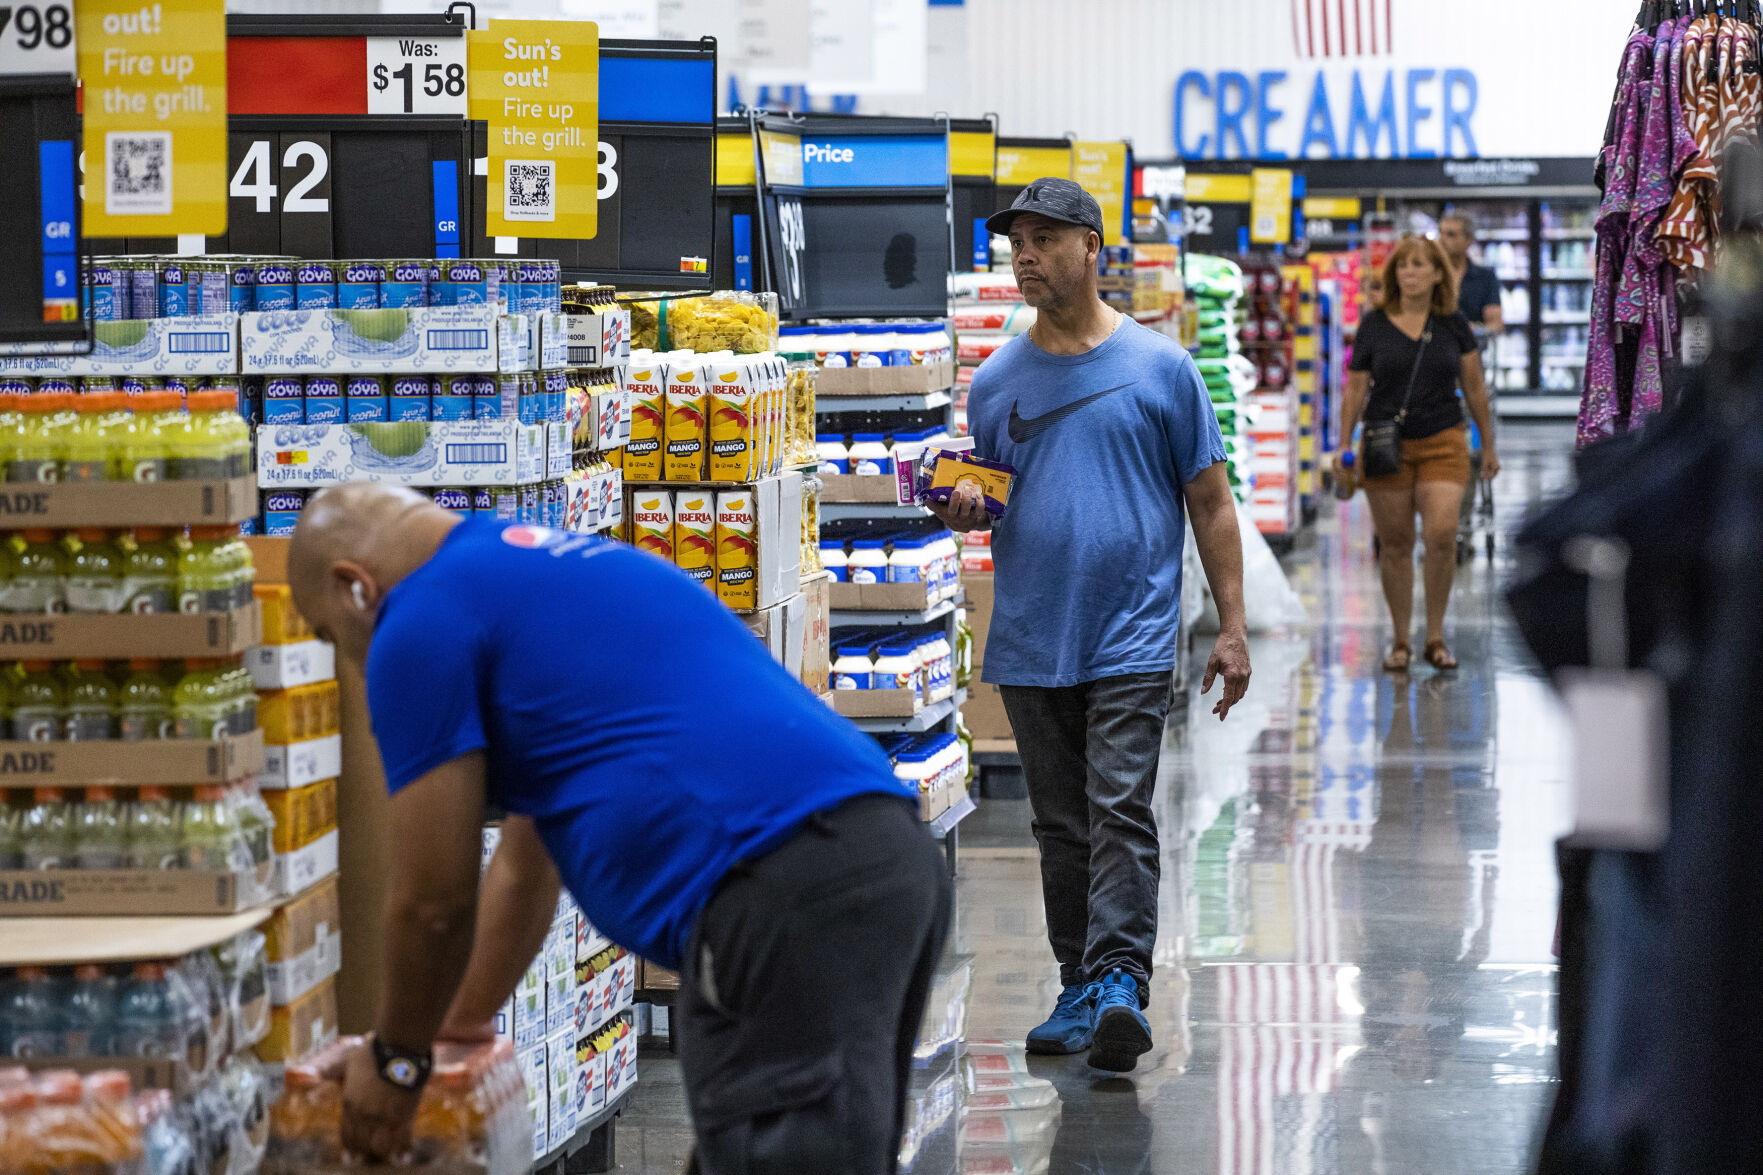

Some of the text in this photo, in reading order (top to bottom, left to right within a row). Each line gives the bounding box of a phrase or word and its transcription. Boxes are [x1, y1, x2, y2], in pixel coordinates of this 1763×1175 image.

[103, 8, 161, 33] out!
[399, 40, 438, 58] Was:
[504, 38, 561, 60] Sun's
[103, 48, 194, 80] Fire up
[503, 66, 548, 88] out!
[103, 87, 212, 119] the grill.
[504, 98, 573, 124] Fire up
[1172, 68, 1479, 160] CREAMER
[502, 126, 586, 151] the grill.
[804, 144, 854, 162] Price
[46, 221, 71, 238] GR
[438, 220, 456, 232] GR
[736, 255, 749, 264] GR
[259, 270, 292, 284] GOYA
[298, 270, 333, 282] GOYA
[346, 269, 378, 282] GOYA
[395, 268, 422, 282] GOY
[4, 358, 18, 369] 17.6
[248, 355, 256, 366] 24
[264, 354, 278, 366] 17.6
[268, 384, 302, 397] GOYA
[306, 384, 338, 396] GOYA
[348, 384, 380, 396] GOYA
[394, 382, 428, 396] GOYA
[626, 384, 660, 396] IBERIA
[669, 384, 702, 396] IBERIA
[712, 384, 746, 396] IBERIA
[627, 442, 658, 452] MANGO
[669, 442, 700, 452] MANGO
[714, 443, 745, 452] MANGO
[266, 470, 275, 480] 24
[282, 469, 296, 480] 17.6
[268, 497, 302, 510] GOYA
[635, 512, 669, 524] IBERIA
[678, 512, 712, 524] IBERIA
[719, 512, 753, 524] IBERIA
[688, 570, 712, 579] ANGO
[721, 570, 753, 581] MANGO
